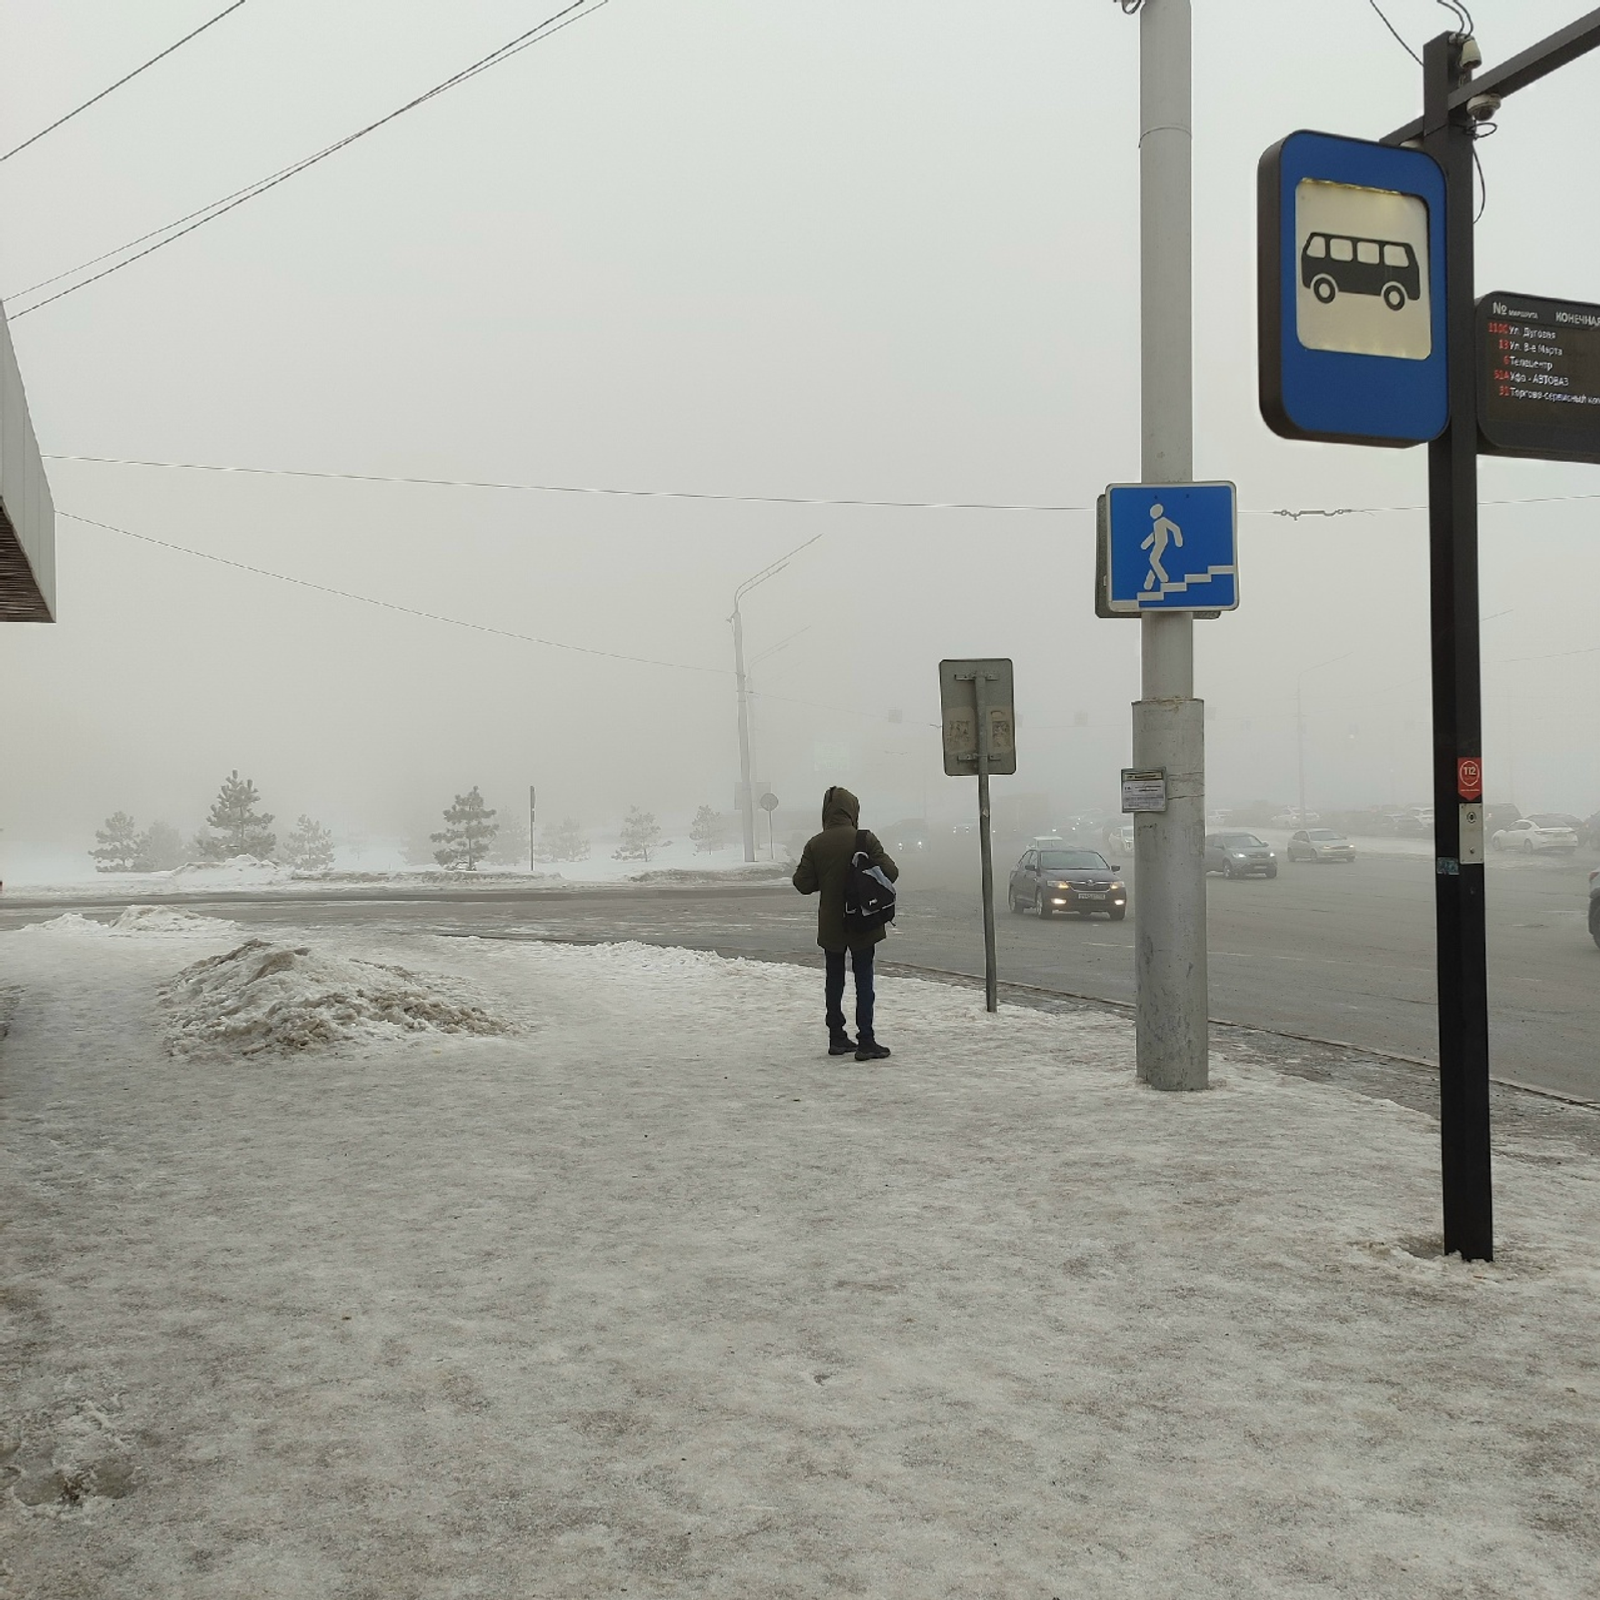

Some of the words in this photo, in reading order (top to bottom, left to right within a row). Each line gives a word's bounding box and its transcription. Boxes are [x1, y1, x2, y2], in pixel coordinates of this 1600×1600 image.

[1493, 302, 1507, 315] №
[1523, 327, 1556, 340] Дуговая
[1499, 339, 1509, 350] 13
[1538, 344, 1563, 356] Марта
[1510, 355, 1553, 371] Телецентр
[1510, 371, 1527, 383] Уфа
[1532, 373, 1569, 386] АВТОВАЗ
[1463, 766, 1476, 776] 112
